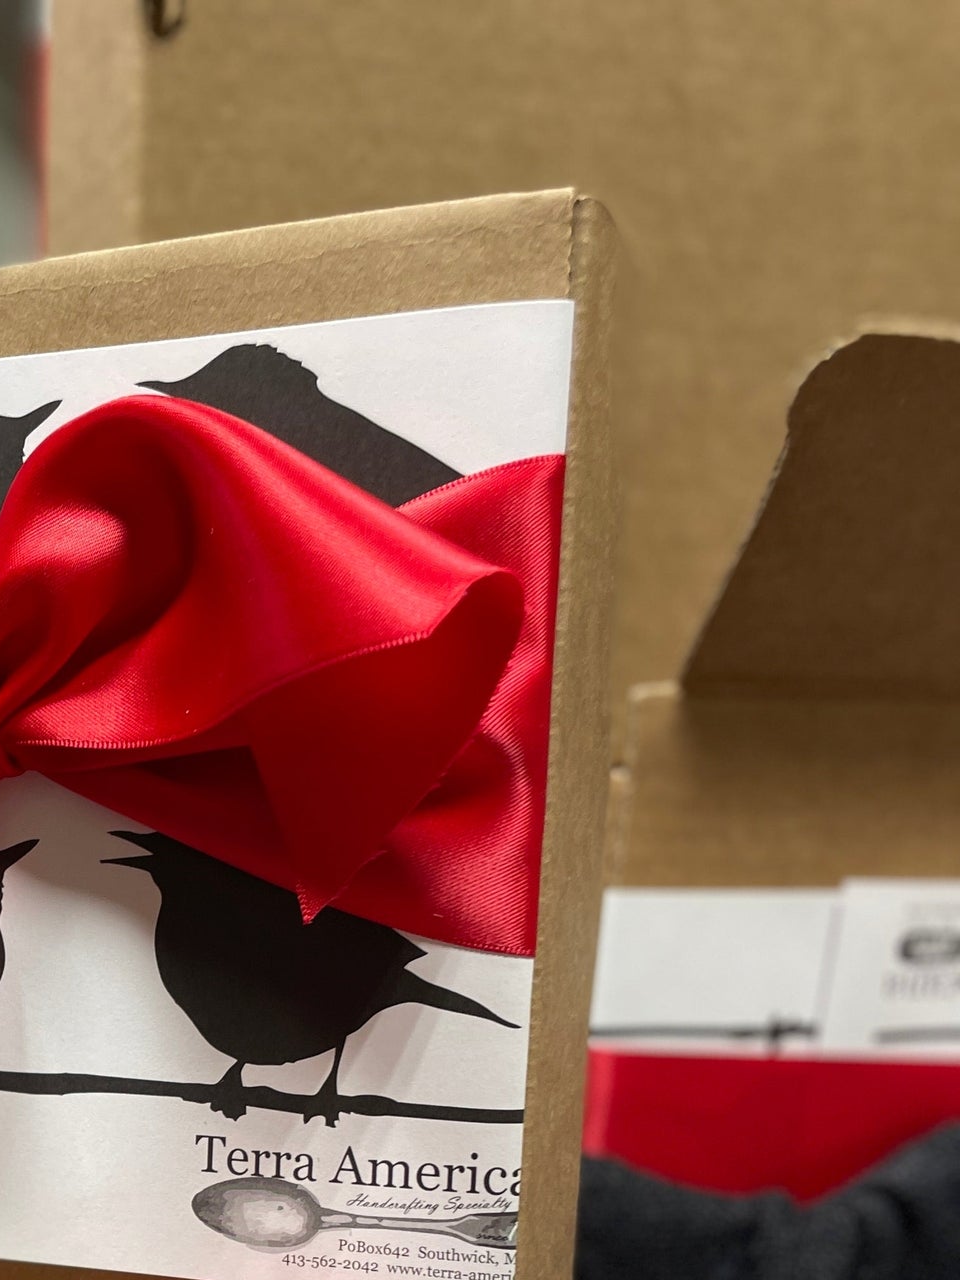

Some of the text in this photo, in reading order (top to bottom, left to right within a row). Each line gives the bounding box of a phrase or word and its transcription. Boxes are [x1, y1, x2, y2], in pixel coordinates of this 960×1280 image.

[195, 1134, 317, 1182] Terra
[346, 1193, 513, 1215] Handcrafting Specialty
[281, 1254, 379, 1274] 413-562-2042
[338, 1238, 410, 1259] PoBox642
[417, 1246, 500, 1267] Southwick,
